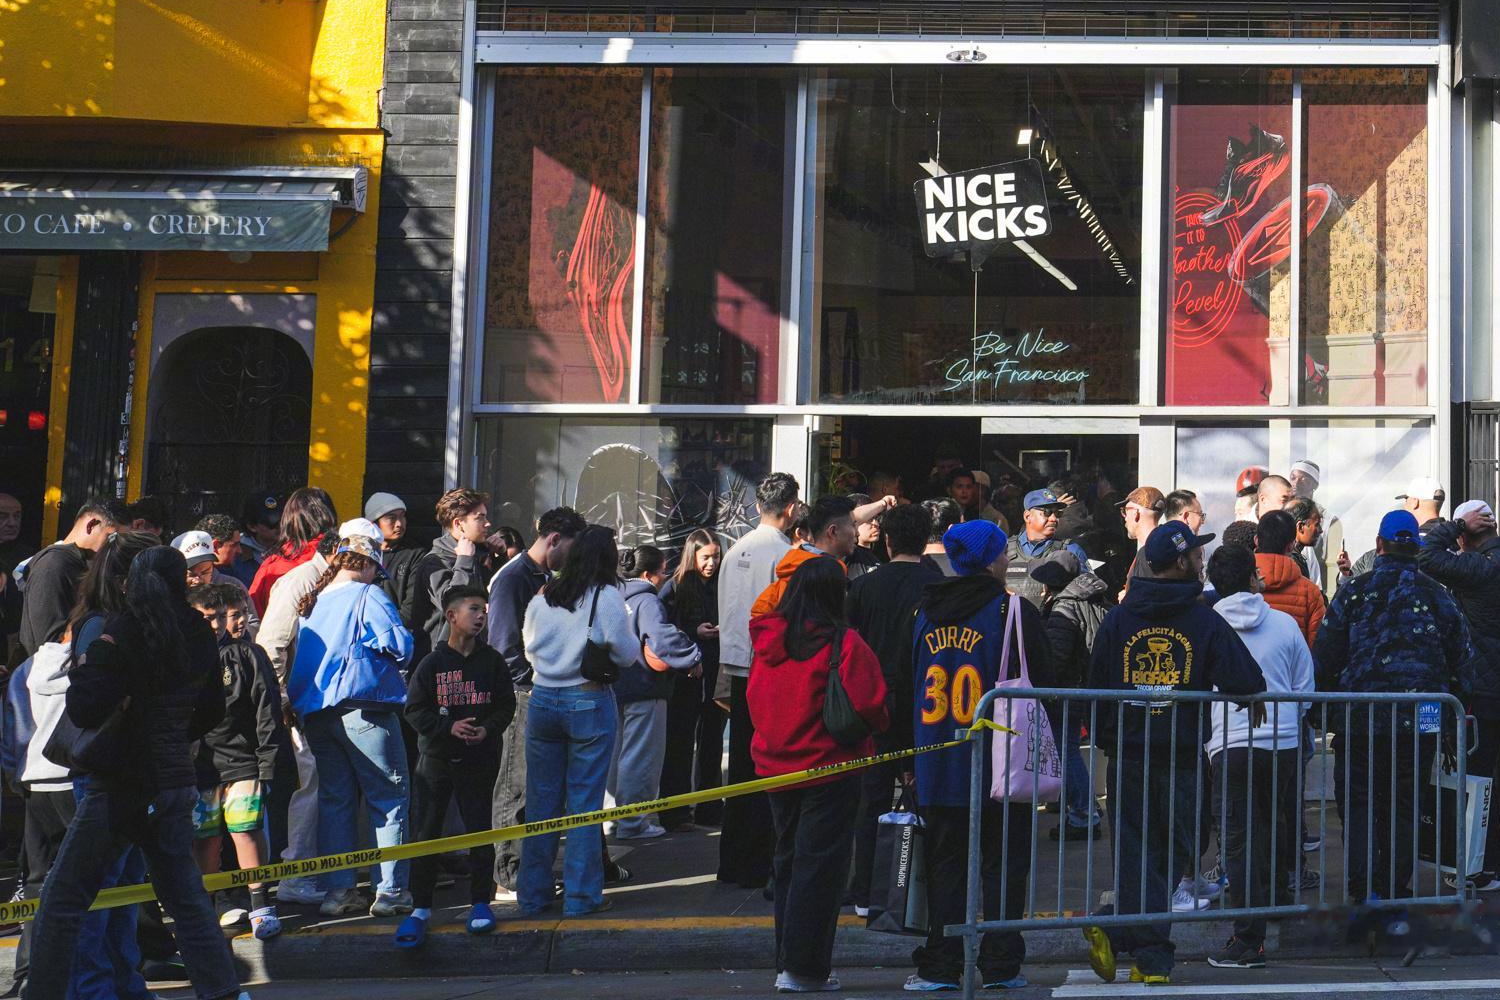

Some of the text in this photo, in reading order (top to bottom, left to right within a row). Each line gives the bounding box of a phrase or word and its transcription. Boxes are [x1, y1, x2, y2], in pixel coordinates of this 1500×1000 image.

[924, 173, 1017, 209] NICE
[0, 213, 272, 236] O CAFE CREPERY
[926, 205, 1047, 244] KICKS
[971, 328, 1070, 361] Be Nice
[944, 358, 1090, 391] San Francisco
[925, 626, 983, 654] CURRY
[436, 670, 463, 684] TEAM
[437, 681, 476, 695] ARSENAL
[1132, 670, 1181, 684] BIGFACE
[437, 692, 491, 707] BASKETBALL
[922, 663, 983, 725] 30
[897, 826, 912, 888] SHOPNICEKICKS.COM
